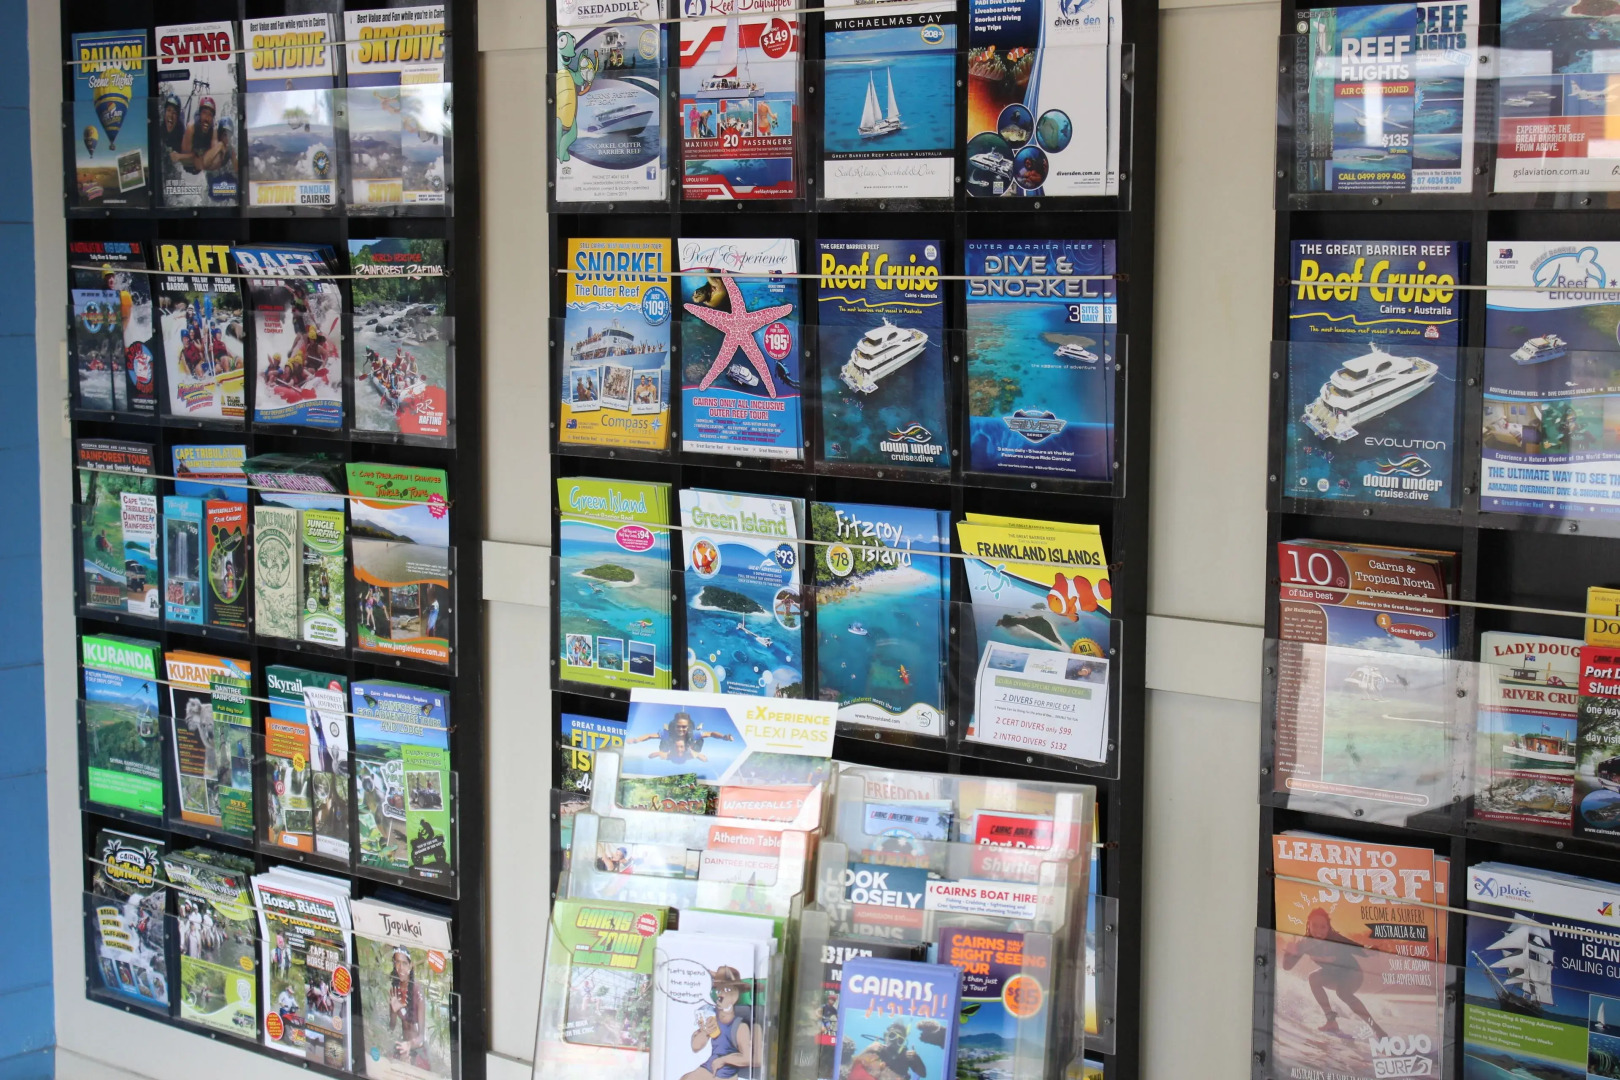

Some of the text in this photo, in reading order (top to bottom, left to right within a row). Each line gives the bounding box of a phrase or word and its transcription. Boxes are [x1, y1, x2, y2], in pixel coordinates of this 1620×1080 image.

[577, 1, 640, 16] SKEDADDLE
[709, 0, 791, 15] Reef Daytripper
[975, 6, 1021, 14] Liveaboard trips
[250, 23, 258, 32] Best
[259, 22, 269, 31] Value
[285, 19, 295, 29] while
[296, 19, 308, 30] you're
[313, 16, 326, 27] Cairns
[835, 14, 942, 29] MICHAELMAS CAY
[1054, 14, 1100, 27] divers den
[358, 23, 444, 63] SKYDIVE
[763, 30, 789, 46] $149
[160, 32, 231, 64] SWING
[252, 31, 325, 70] SKYDIVE
[1341, 35, 1411, 64] REEF
[81, 44, 142, 73] BALLOON
[1341, 65, 1409, 81] FLIGHTS
[88, 74, 133, 90] Scenic Flights
[1517, 124, 1571, 134] EXPERIENCE THE
[685, 134, 792, 148] MAXIMUM 20 PASSENGERS
[1381, 134, 1408, 147] $135
[1516, 133, 1585, 142] GREAT BARRIER REEF
[1515, 143, 1559, 152] FROM ABOVE.
[1513, 168, 1590, 178] gslaviation.com.au
[300, 185, 330, 194] TANDEM
[300, 194, 330, 204] CAIRNS
[683, 244, 788, 270] Reef Experience
[1300, 244, 1451, 256] THE GREAT BARRIER REEF
[161, 245, 230, 275] RAFT
[575, 251, 668, 282] SNORKEL
[984, 256, 1074, 275] DIVE &
[821, 252, 939, 291] Reef Cruise
[970, 278, 1099, 298] SNORKEL
[1297, 257, 1454, 303] Reef Cruise
[575, 285, 639, 297] The Outer Reef
[1069, 305, 1080, 322] 3
[1081, 305, 1099, 314] SITES
[1081, 313, 1099, 322] DAILY
[1380, 305, 1452, 315] Cairns Australia
[693, 397, 785, 411] CAIRNS ONLY ALL INCLUSIVE
[709, 408, 769, 420] OUTER REEF TOUR!
[601, 414, 648, 431] Compass
[880, 441, 942, 455] down under
[1365, 436, 1446, 450] EVOLUTION
[81, 449, 150, 466] RAINFOREST TOURS
[175, 448, 243, 460] CAPE TRIBULATION
[1488, 467, 1606, 484] THE ULTIMATE WAY TO SEE
[1363, 476, 1443, 492] down under
[123, 496, 138, 504] CAPE
[569, 486, 648, 514] Green Island
[1375, 490, 1429, 501] cruise&dive
[123, 512, 149, 521] DAINTREE
[125, 504, 156, 513] TRIBULATION
[124, 522, 155, 530] RAINFOREST
[307, 519, 335, 530] JUNGLE
[691, 507, 787, 537] Green Island
[835, 510, 904, 543] Fitzroy
[309, 528, 340, 539] SURFING
[776, 549, 794, 565] $93
[834, 551, 849, 568] 78
[862, 542, 912, 568] island
[977, 541, 1101, 566] FRANKLAND ISLANDS
[1287, 549, 1333, 586] 10
[1369, 560, 1416, 574] Cairns &
[1355, 571, 1435, 590] Tropical North
[1391, 627, 1427, 637] Scenic Flights
[378, 640, 446, 658] www.jungletours.com.au
[1494, 642, 1580, 658] LADY DOUG
[89, 644, 154, 672] KURANDA
[1585, 665, 1613, 678] Port
[267, 674, 303, 693] Skyrail
[746, 706, 830, 726] EXPERIENCE
[572, 720, 627, 736] GREAT BARRIER
[745, 724, 828, 743] FLEXI PASS
[999, 733, 1021, 742] INTRO
[1023, 736, 1046, 746] DIVERS
[1051, 741, 1067, 750] $132
[713, 832, 754, 845] Atherton
[1277, 840, 1397, 868] LEARN TO
[1316, 867, 1431, 904] SURF
[936, 884, 1038, 904] CAIRNS BOAT HIRE
[261, 892, 338, 923] Horse Riding
[378, 913, 422, 938] Tjapukai
[952, 935, 1004, 951] CAIRNS
[1561, 957, 1603, 975] SAILING
[848, 974, 935, 1001] CAIRNS
[865, 994, 948, 1018] digital!
[1369, 1034, 1431, 1057] MOJO
[1375, 1060, 1412, 1075] SURF
